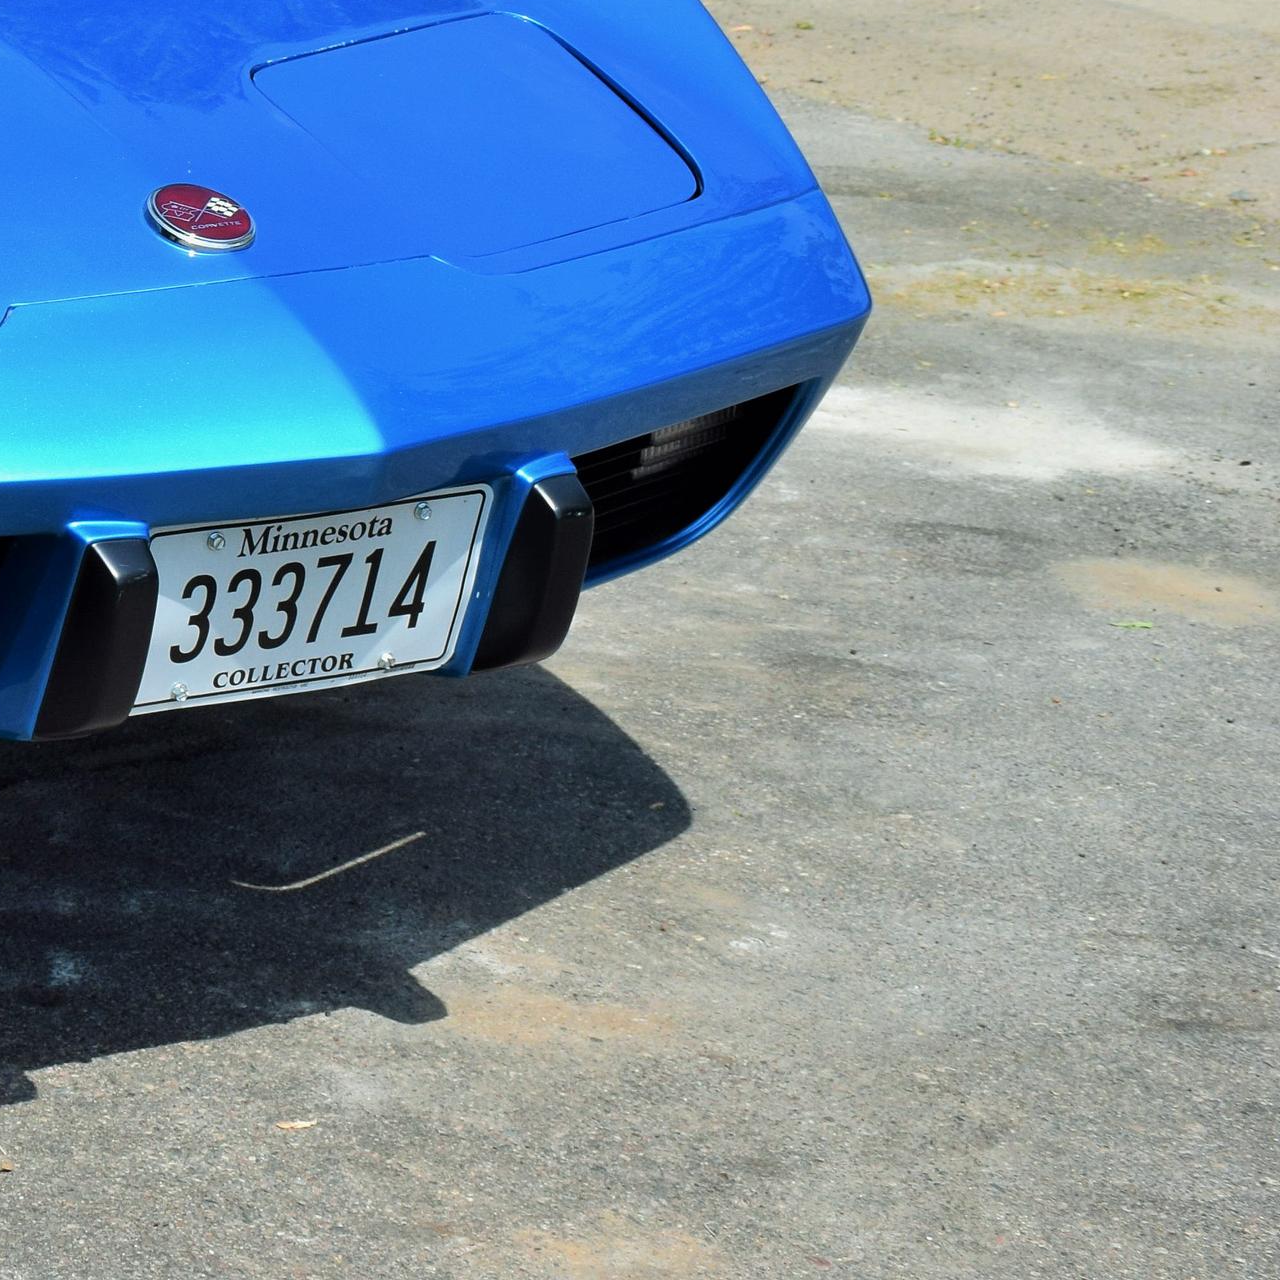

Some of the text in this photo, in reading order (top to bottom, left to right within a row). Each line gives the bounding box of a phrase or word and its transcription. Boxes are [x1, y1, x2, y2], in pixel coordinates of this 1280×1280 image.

[191, 220, 242, 230] CORVETTE
[237, 517, 392, 557] Minnesota
[169, 540, 437, 664] 333714
[213, 652, 354, 689] COLLECTOR
